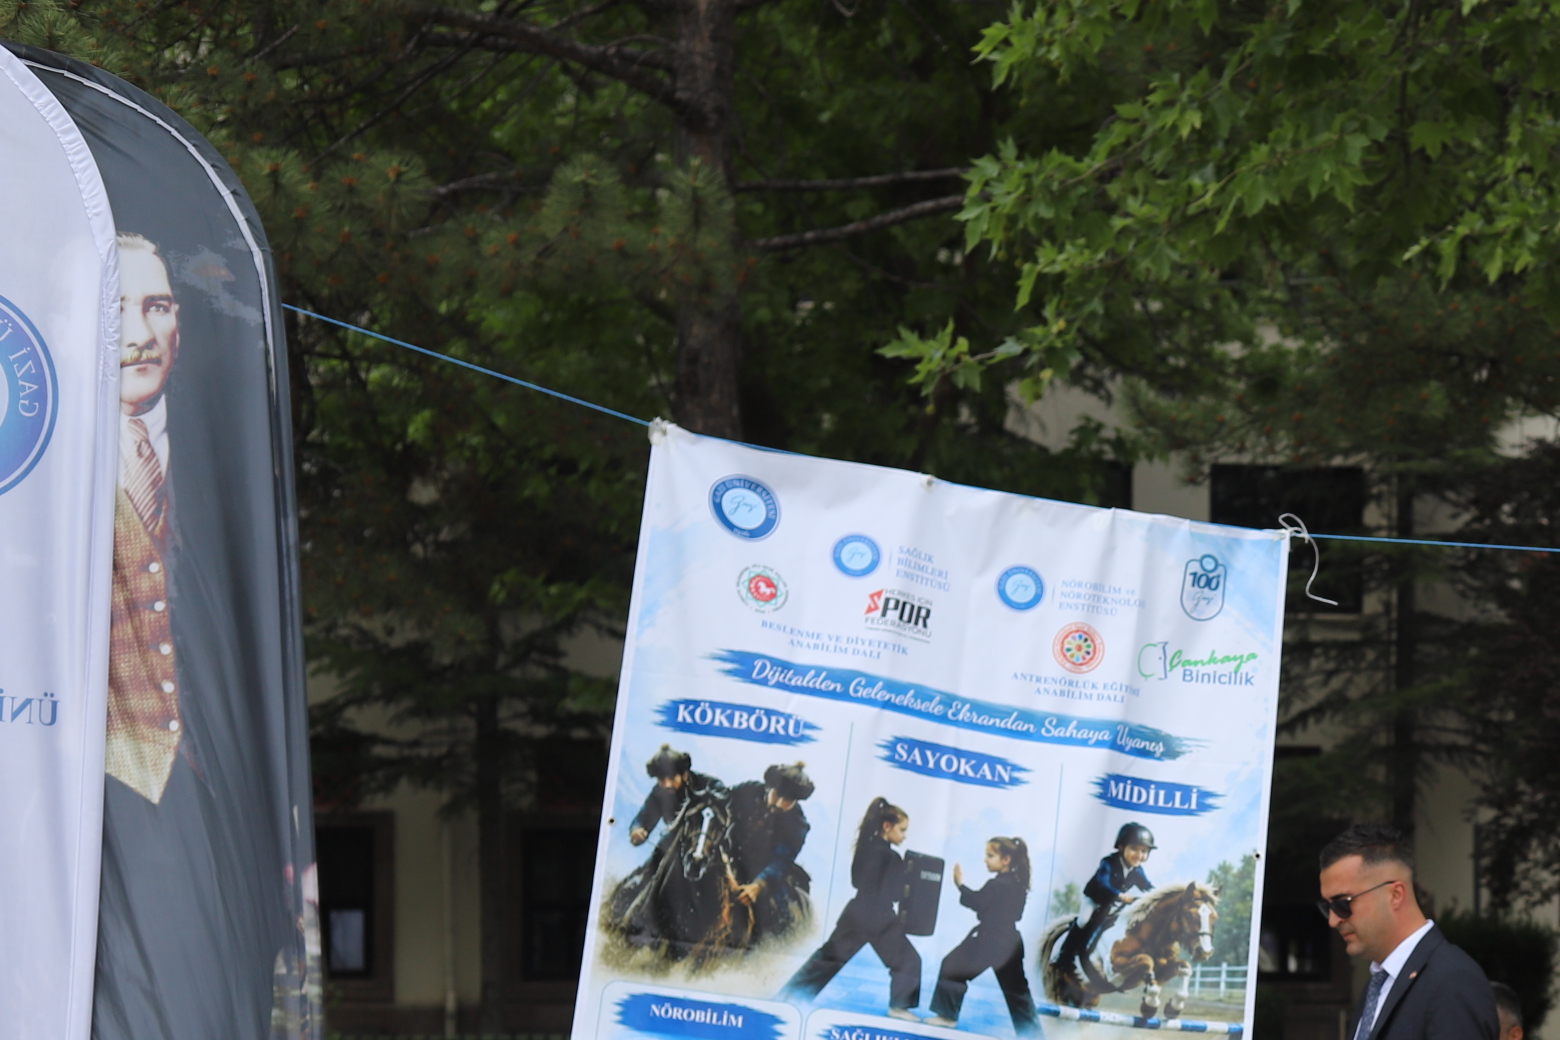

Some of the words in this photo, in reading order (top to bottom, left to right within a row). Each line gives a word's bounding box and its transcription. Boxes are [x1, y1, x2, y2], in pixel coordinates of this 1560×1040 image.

[898, 546, 935, 564] SAĞLIK
[897, 557, 948, 579] BİLİMLERİ
[895, 569, 950, 592] ENSTİTÜSÜ
[1061, 579, 1122, 595] NÖROBİLİM
[1189, 570, 1221, 592] 100
[864, 588, 931, 628] SPOR
[1059, 602, 1118, 616] ENSTİTÜSÜ
[761, 620, 823, 641] BESLENME
[828, 632, 845, 643] VE
[846, 635, 909, 655] DİYETETİK
[864, 617, 932, 638] FEDERASYONU
[788, 638, 848, 655] ANABİLİM
[852, 648, 881, 660] DALI
[1168, 648, 1258, 674] Çankaya
[1011, 672, 1099, 690] ANTRENÖRLÜK
[1182, 668, 1254, 686] Binicilik
[1034, 687, 1093, 701] ANABİLİM
[1096, 693, 1125, 704] DALI
[751, 658, 843, 694] Dijitalden
[848, 677, 943, 718] Geleneksele
[947, 700, 1036, 733] Ekrandan
[1041, 717, 1112, 744] Sahaya
[1116, 724, 1166, 758] Uyanış
[677, 702, 804, 738] KÖKBÖRÜ
[894, 742, 1012, 784] SAYOKAN
[1107, 780, 1199, 810] MİDİLLİ
[650, 1002, 743, 1028] NÖROBİLİM
